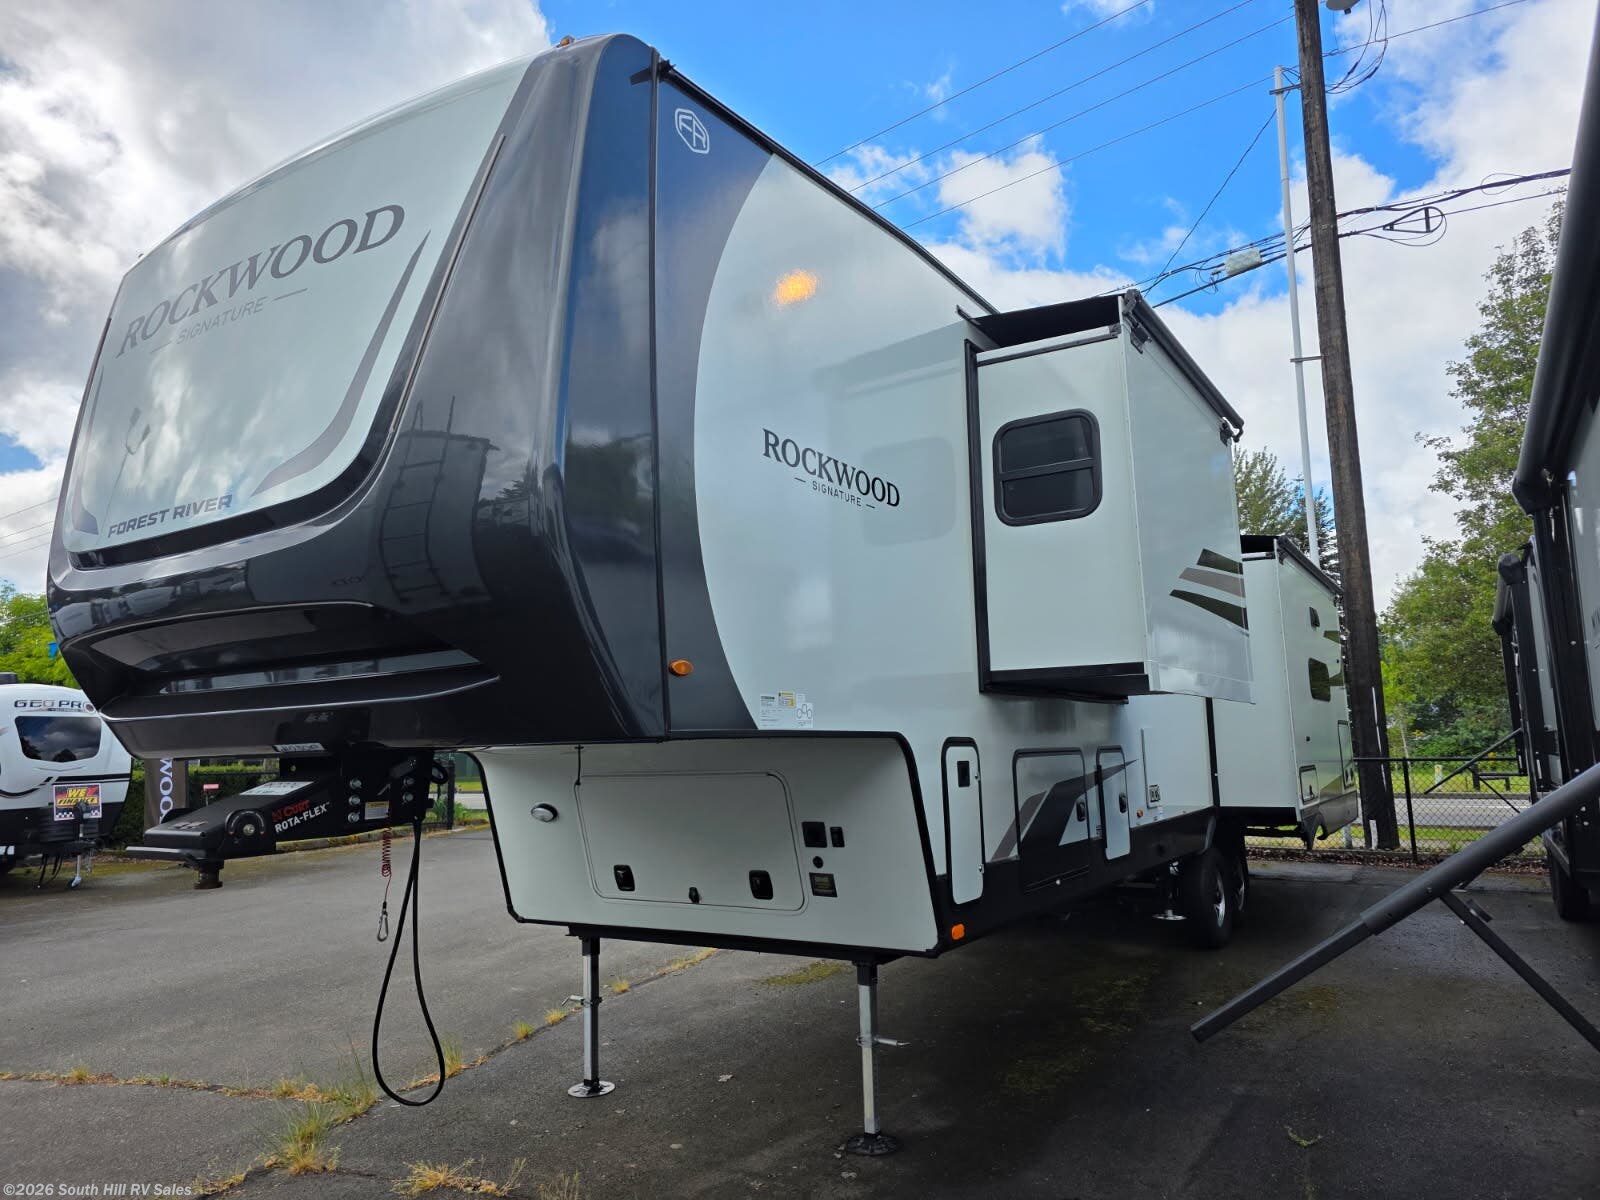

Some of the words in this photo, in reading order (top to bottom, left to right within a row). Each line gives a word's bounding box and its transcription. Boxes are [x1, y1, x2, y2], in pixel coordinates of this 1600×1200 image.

[116, 204, 405, 359] ROCKWOOD
[177, 296, 268, 345] SIGNATURE
[762, 428, 900, 507] ROCKWOOD
[107, 508, 171, 539] FOREST
[172, 494, 234, 521] RIVER
[812, 480, 862, 507] SIGNATURE
[14, 699, 55, 709] GEO
[67, 787, 88, 798] WE
[159, 757, 173, 823] WOO
